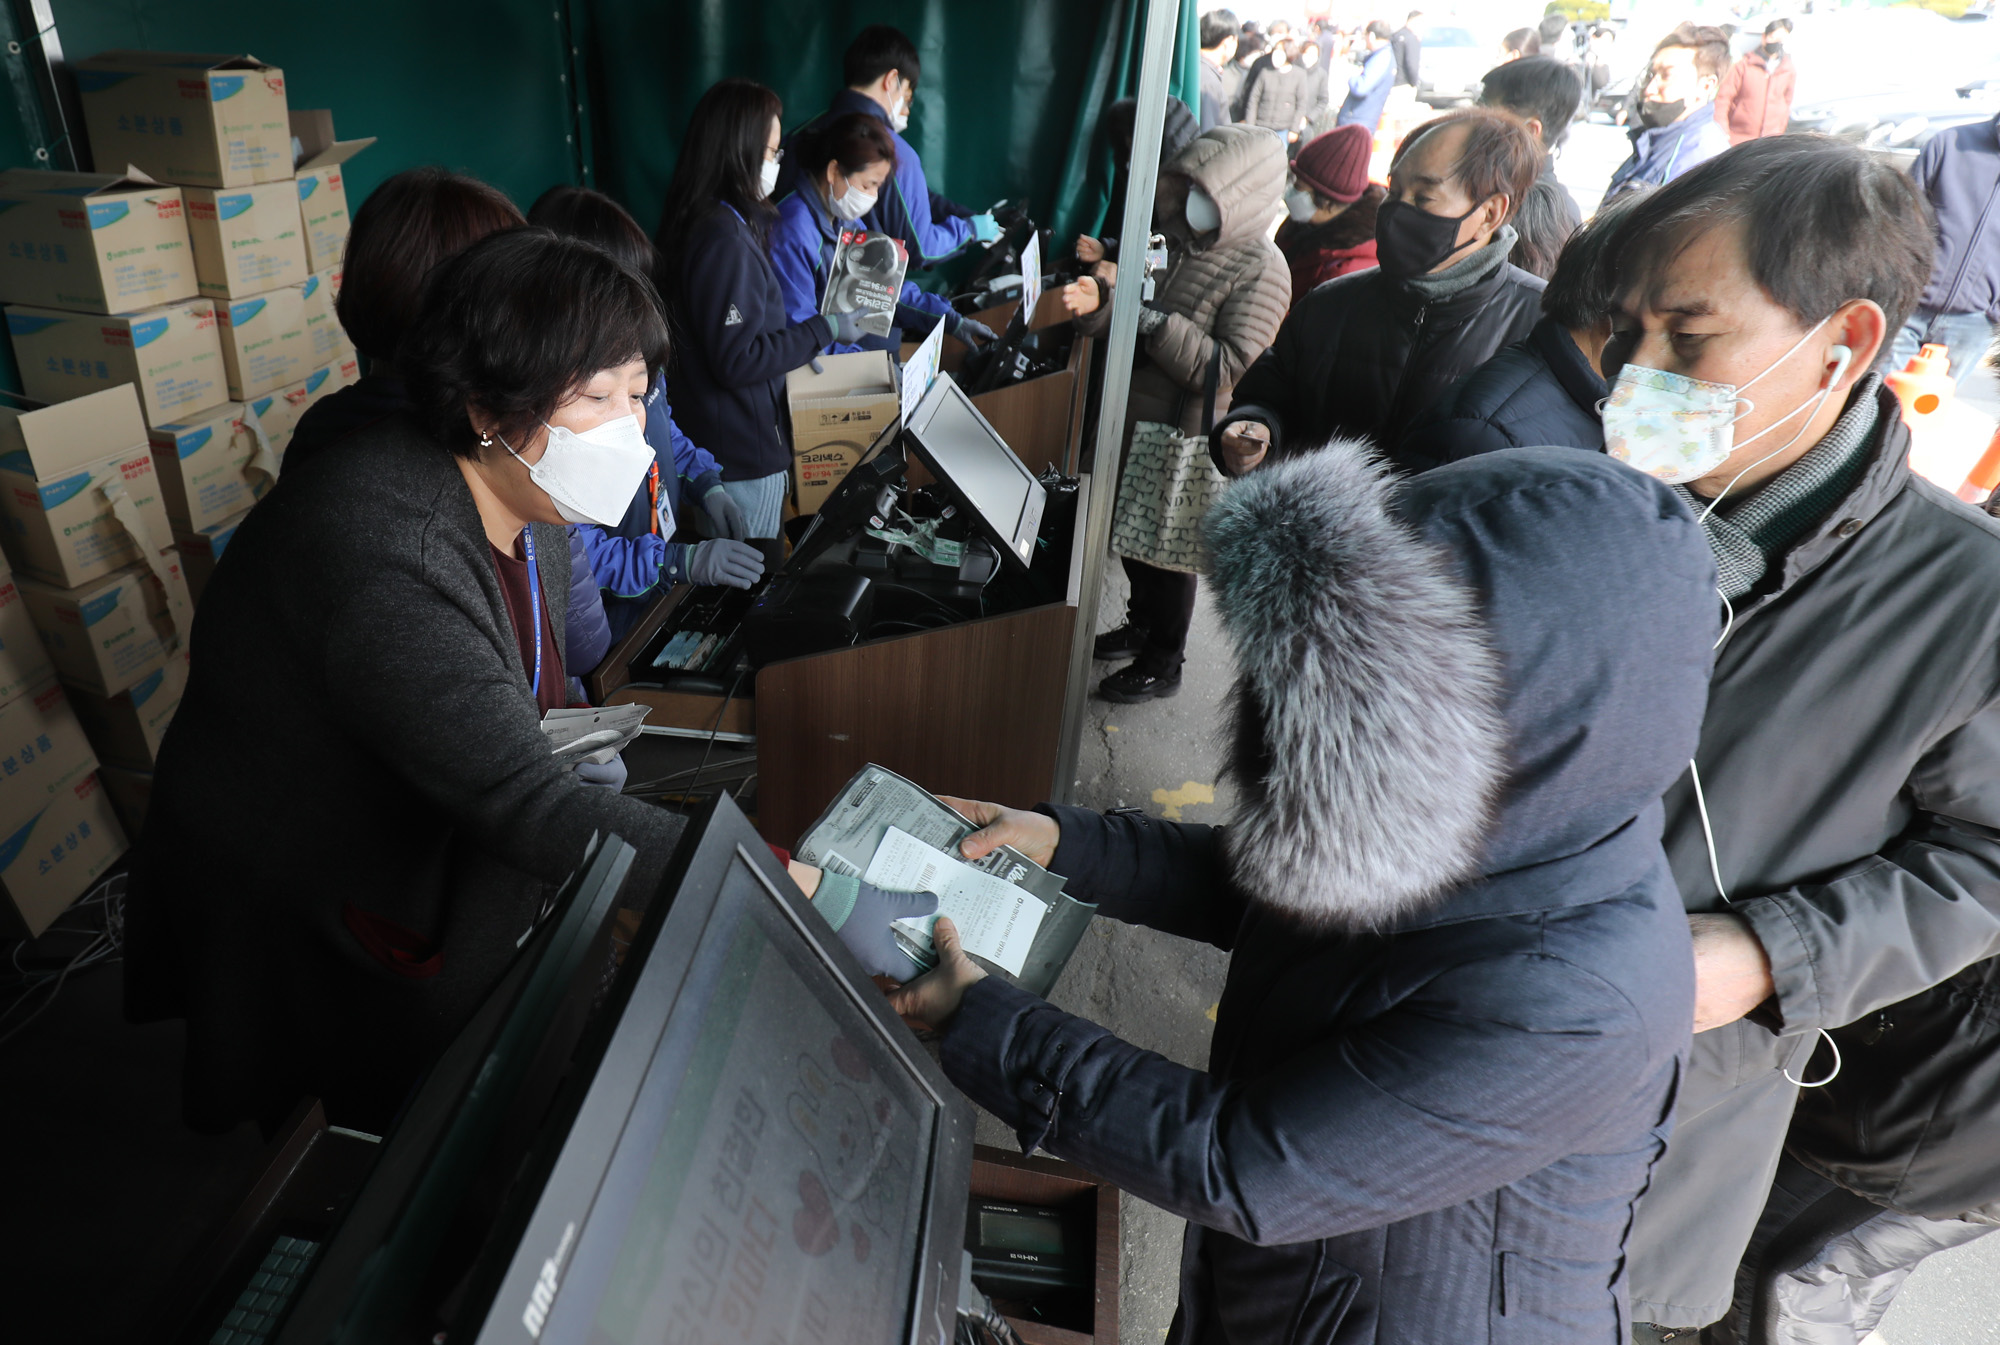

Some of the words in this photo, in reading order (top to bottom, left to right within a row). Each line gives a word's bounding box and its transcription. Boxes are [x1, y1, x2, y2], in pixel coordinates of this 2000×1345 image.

[116, 113, 184, 137] 소분상품
[8, 240, 69, 264] 소분상품
[46, 356, 109, 380] 소분상품
[801, 452, 844, 463] 크리넥스
[123, 465, 152, 480] 취급주의
[0, 734, 53, 782] 분상품
[36, 819, 93, 876] 소분상품
[1005, 862, 1028, 884] Klee
